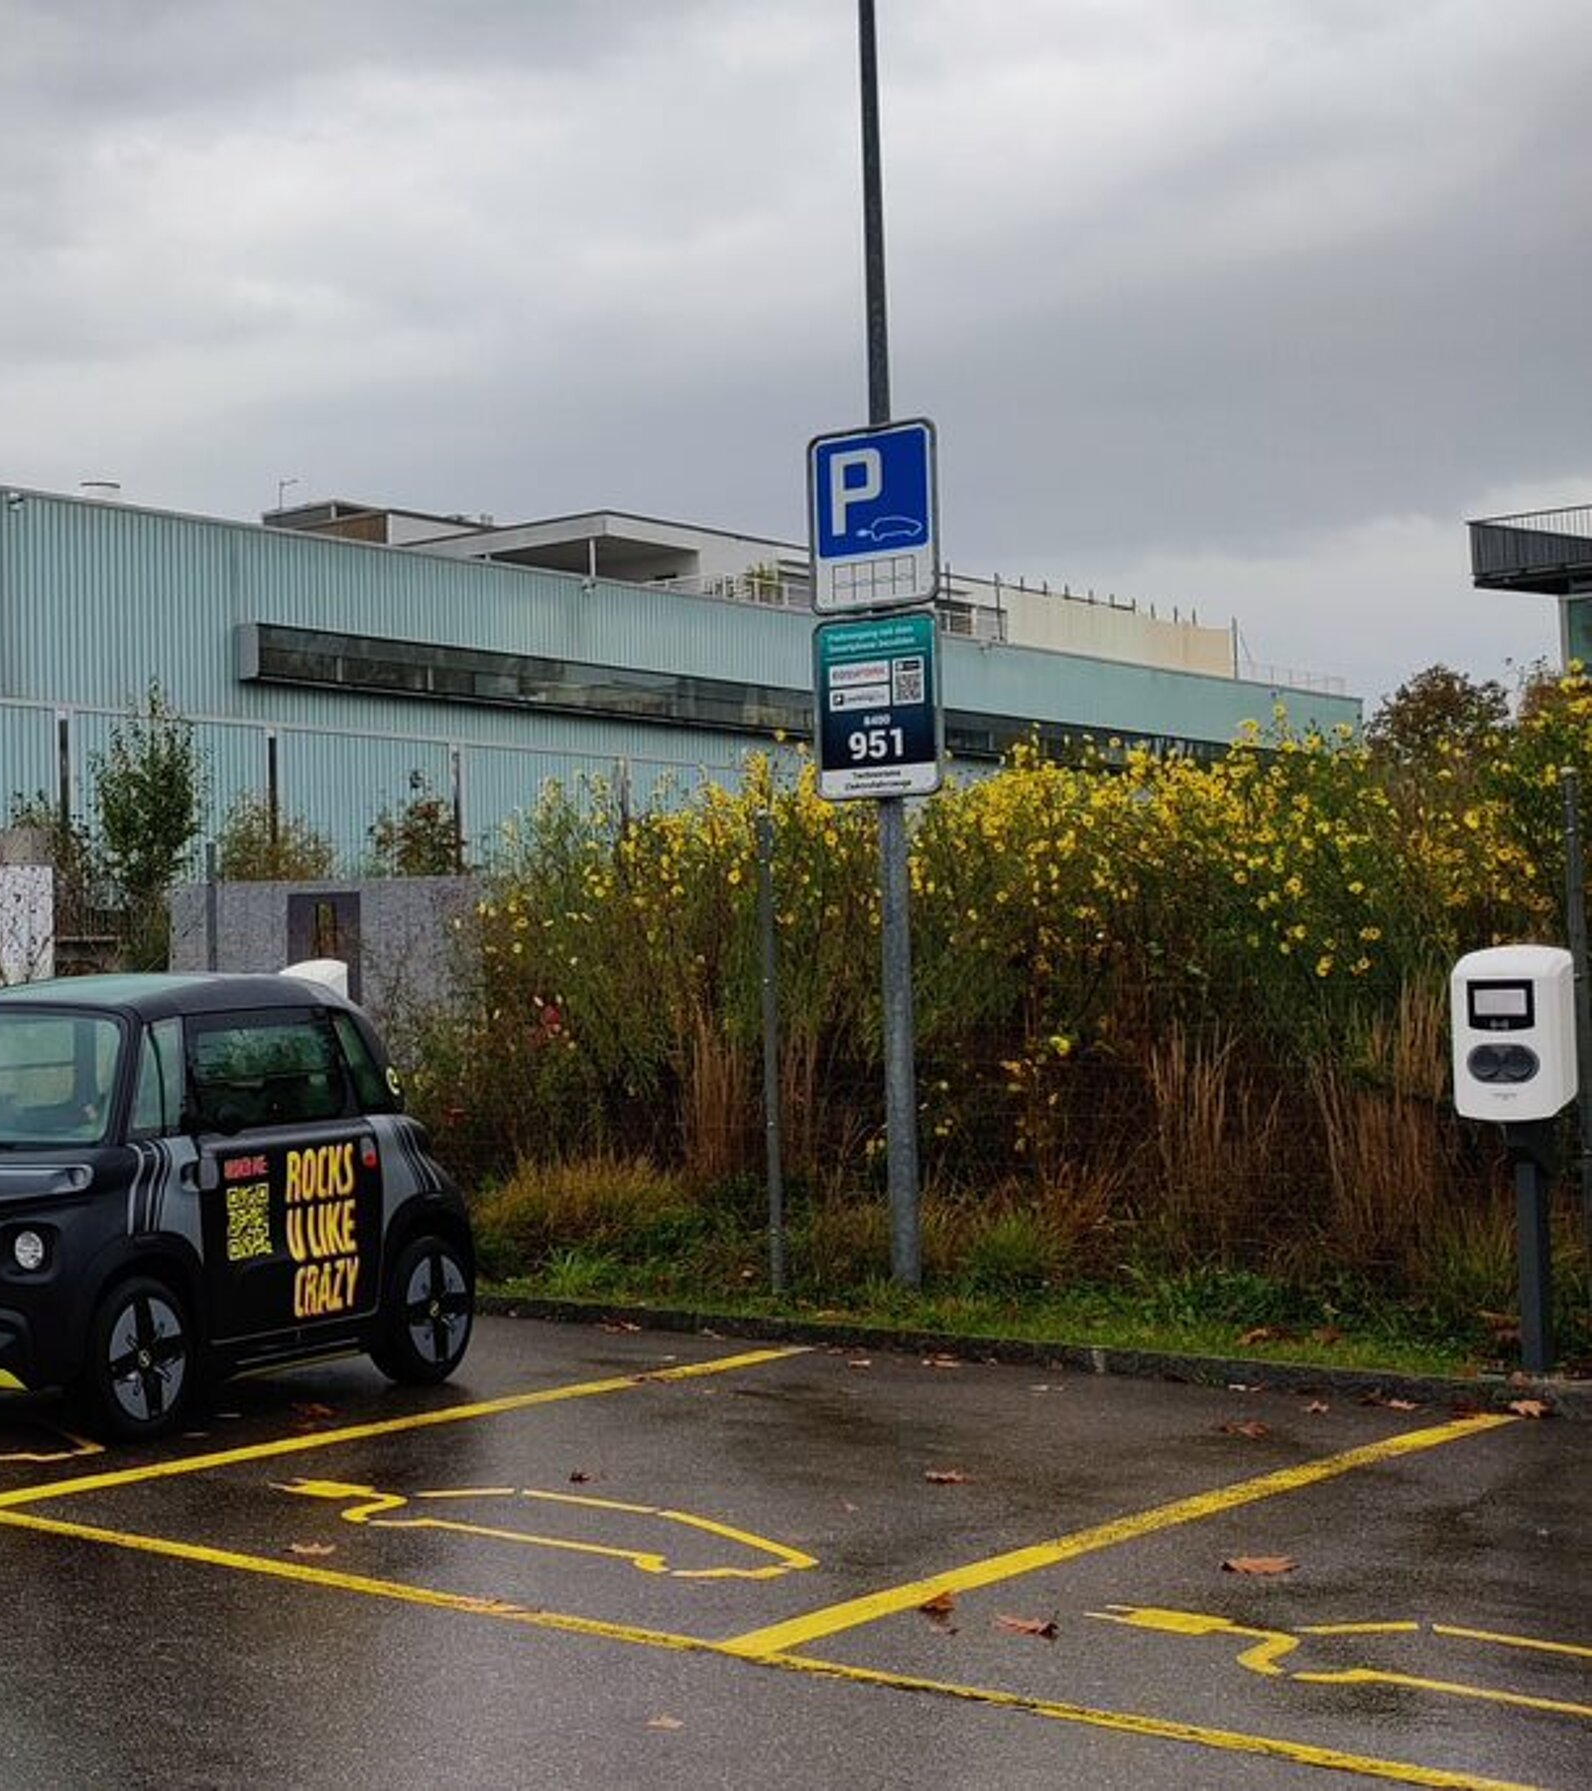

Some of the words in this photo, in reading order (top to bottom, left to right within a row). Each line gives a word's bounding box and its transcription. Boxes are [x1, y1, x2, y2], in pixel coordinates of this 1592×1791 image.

[830, 447, 883, 537] P
[848, 727, 904, 760] 951
[286, 1142, 354, 1203] ROCKS
[286, 1207, 307, 1261] U
[308, 1199, 357, 1258] LIKE
[294, 1255, 360, 1318] CRAZY
